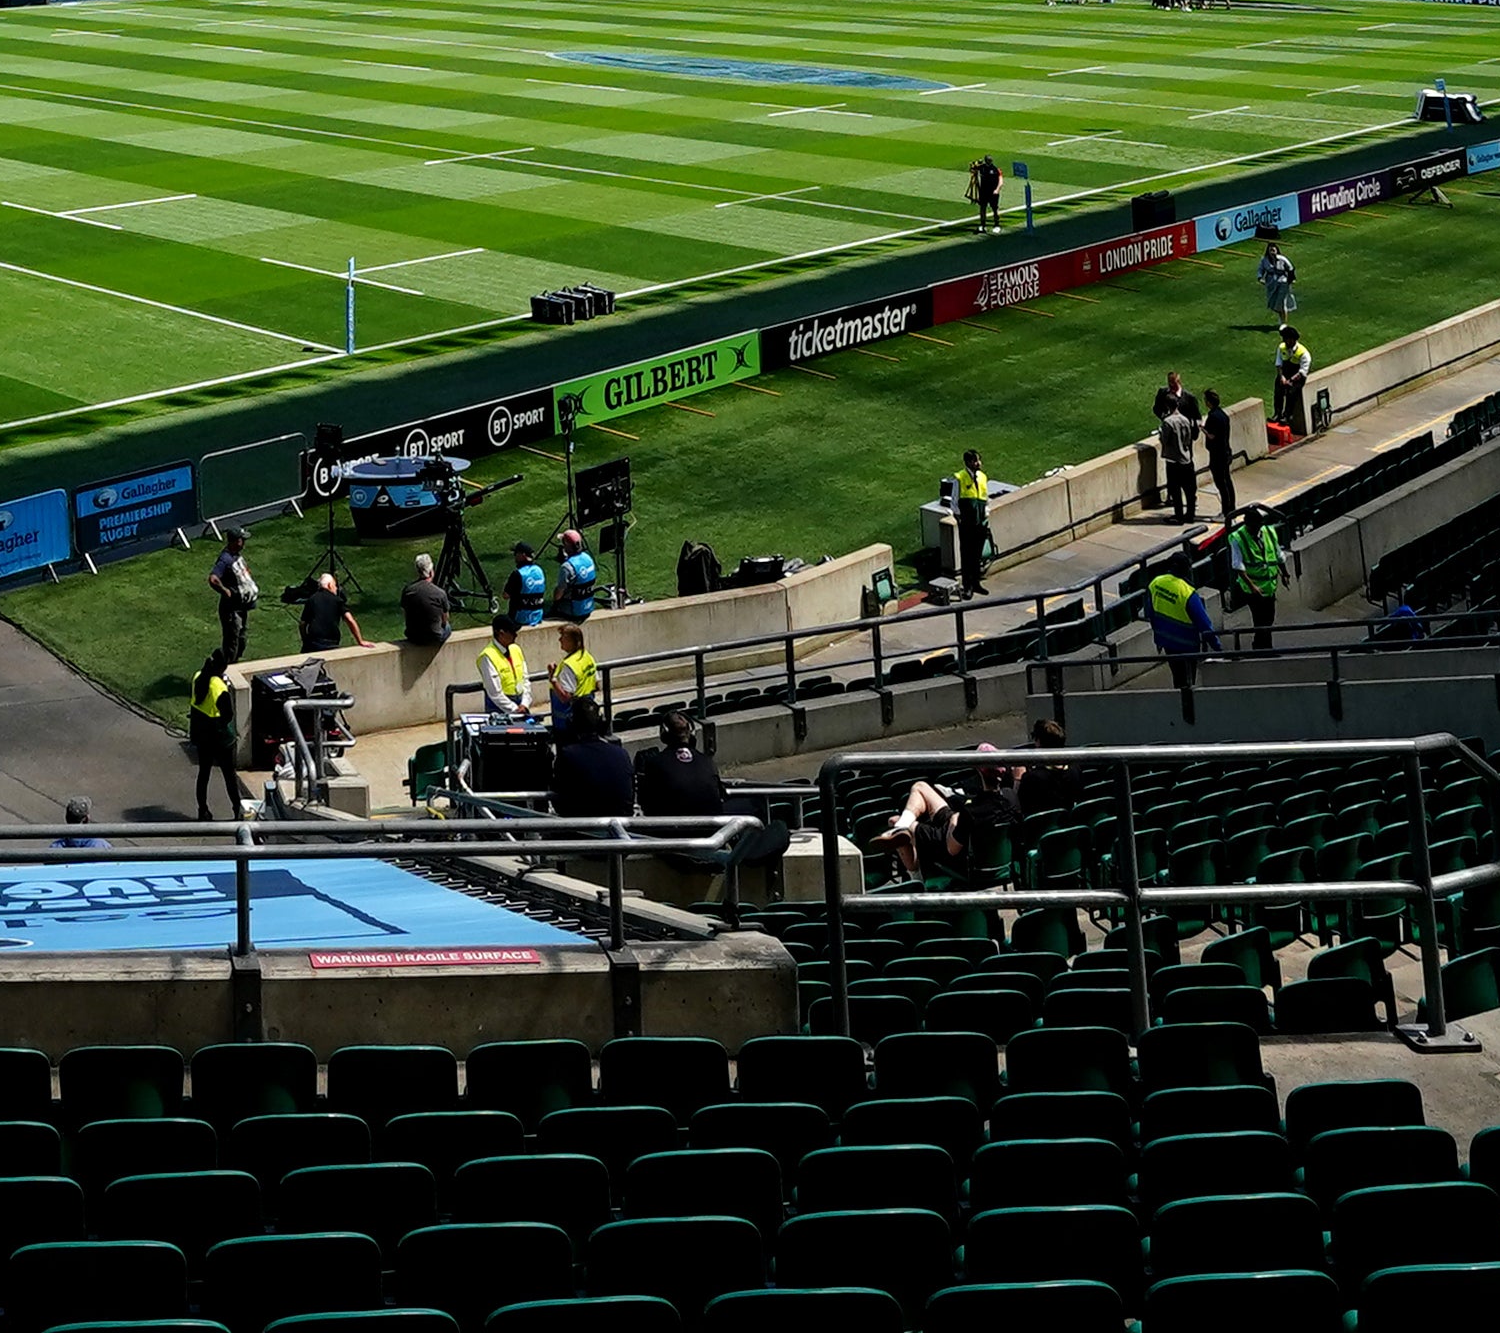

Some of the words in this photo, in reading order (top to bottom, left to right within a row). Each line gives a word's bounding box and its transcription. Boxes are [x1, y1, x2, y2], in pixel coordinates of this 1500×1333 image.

[1420, 159, 1462, 181] DEFENDER
[1320, 181, 1356, 210] Funding
[1357, 177, 1381, 202] Circle
[1234, 206, 1282, 233] Gallagher
[1100, 242, 1141, 274] LONDON
[1144, 234, 1174, 261] PRIDE
[998, 263, 1040, 288] FAMOUS
[998, 283, 1040, 308] GROUSE
[604, 350, 718, 410] GILBERT
[493, 419, 507, 435] BT
[513, 407, 545, 430] SPORT
[410, 442, 424, 458] BT
[431, 429, 465, 453] SPORT
[121, 476, 177, 501] Gallagher
[100, 501, 172, 530] PREMIERSHIP
[100, 524, 140, 544] RUGBY
[316, 954, 393, 964] WARNING!
[463, 950, 533, 961] SURFACE
